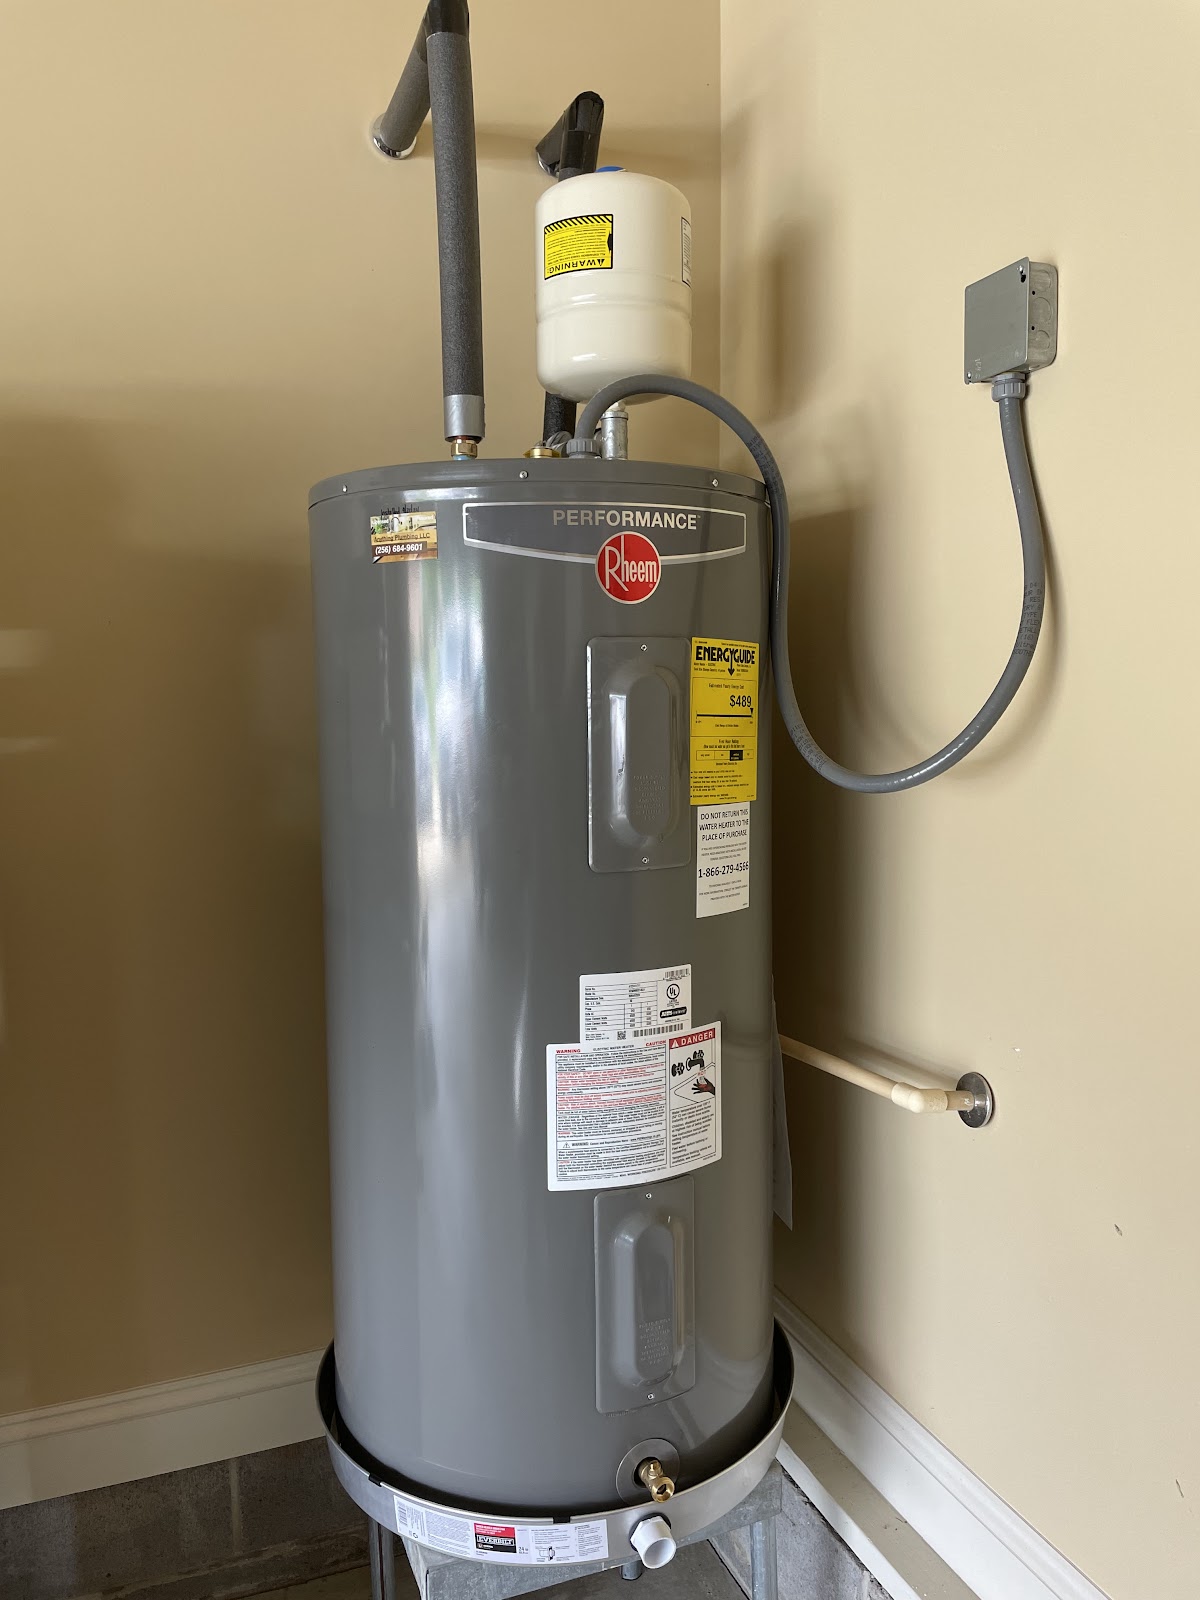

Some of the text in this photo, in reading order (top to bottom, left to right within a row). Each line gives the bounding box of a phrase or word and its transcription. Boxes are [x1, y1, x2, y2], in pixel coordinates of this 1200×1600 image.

[552, 509, 697, 530] PERFORMANCE
[376, 543, 422, 555] (256) 684-9601
[604, 534, 658, 592] Rheem
[696, 646, 756, 664] ENERGYGUIDE
[730, 694, 752, 708] $489
[722, 810, 740, 818] RETURN
[699, 823, 718, 831] WATER
[718, 820, 736, 829] HEATER
[702, 833, 718, 841] PLACE
[726, 830, 747, 839] PURCHASE
[698, 861, 749, 878] 1-866-279-4566
[681, 1031, 713, 1046] DANGER
